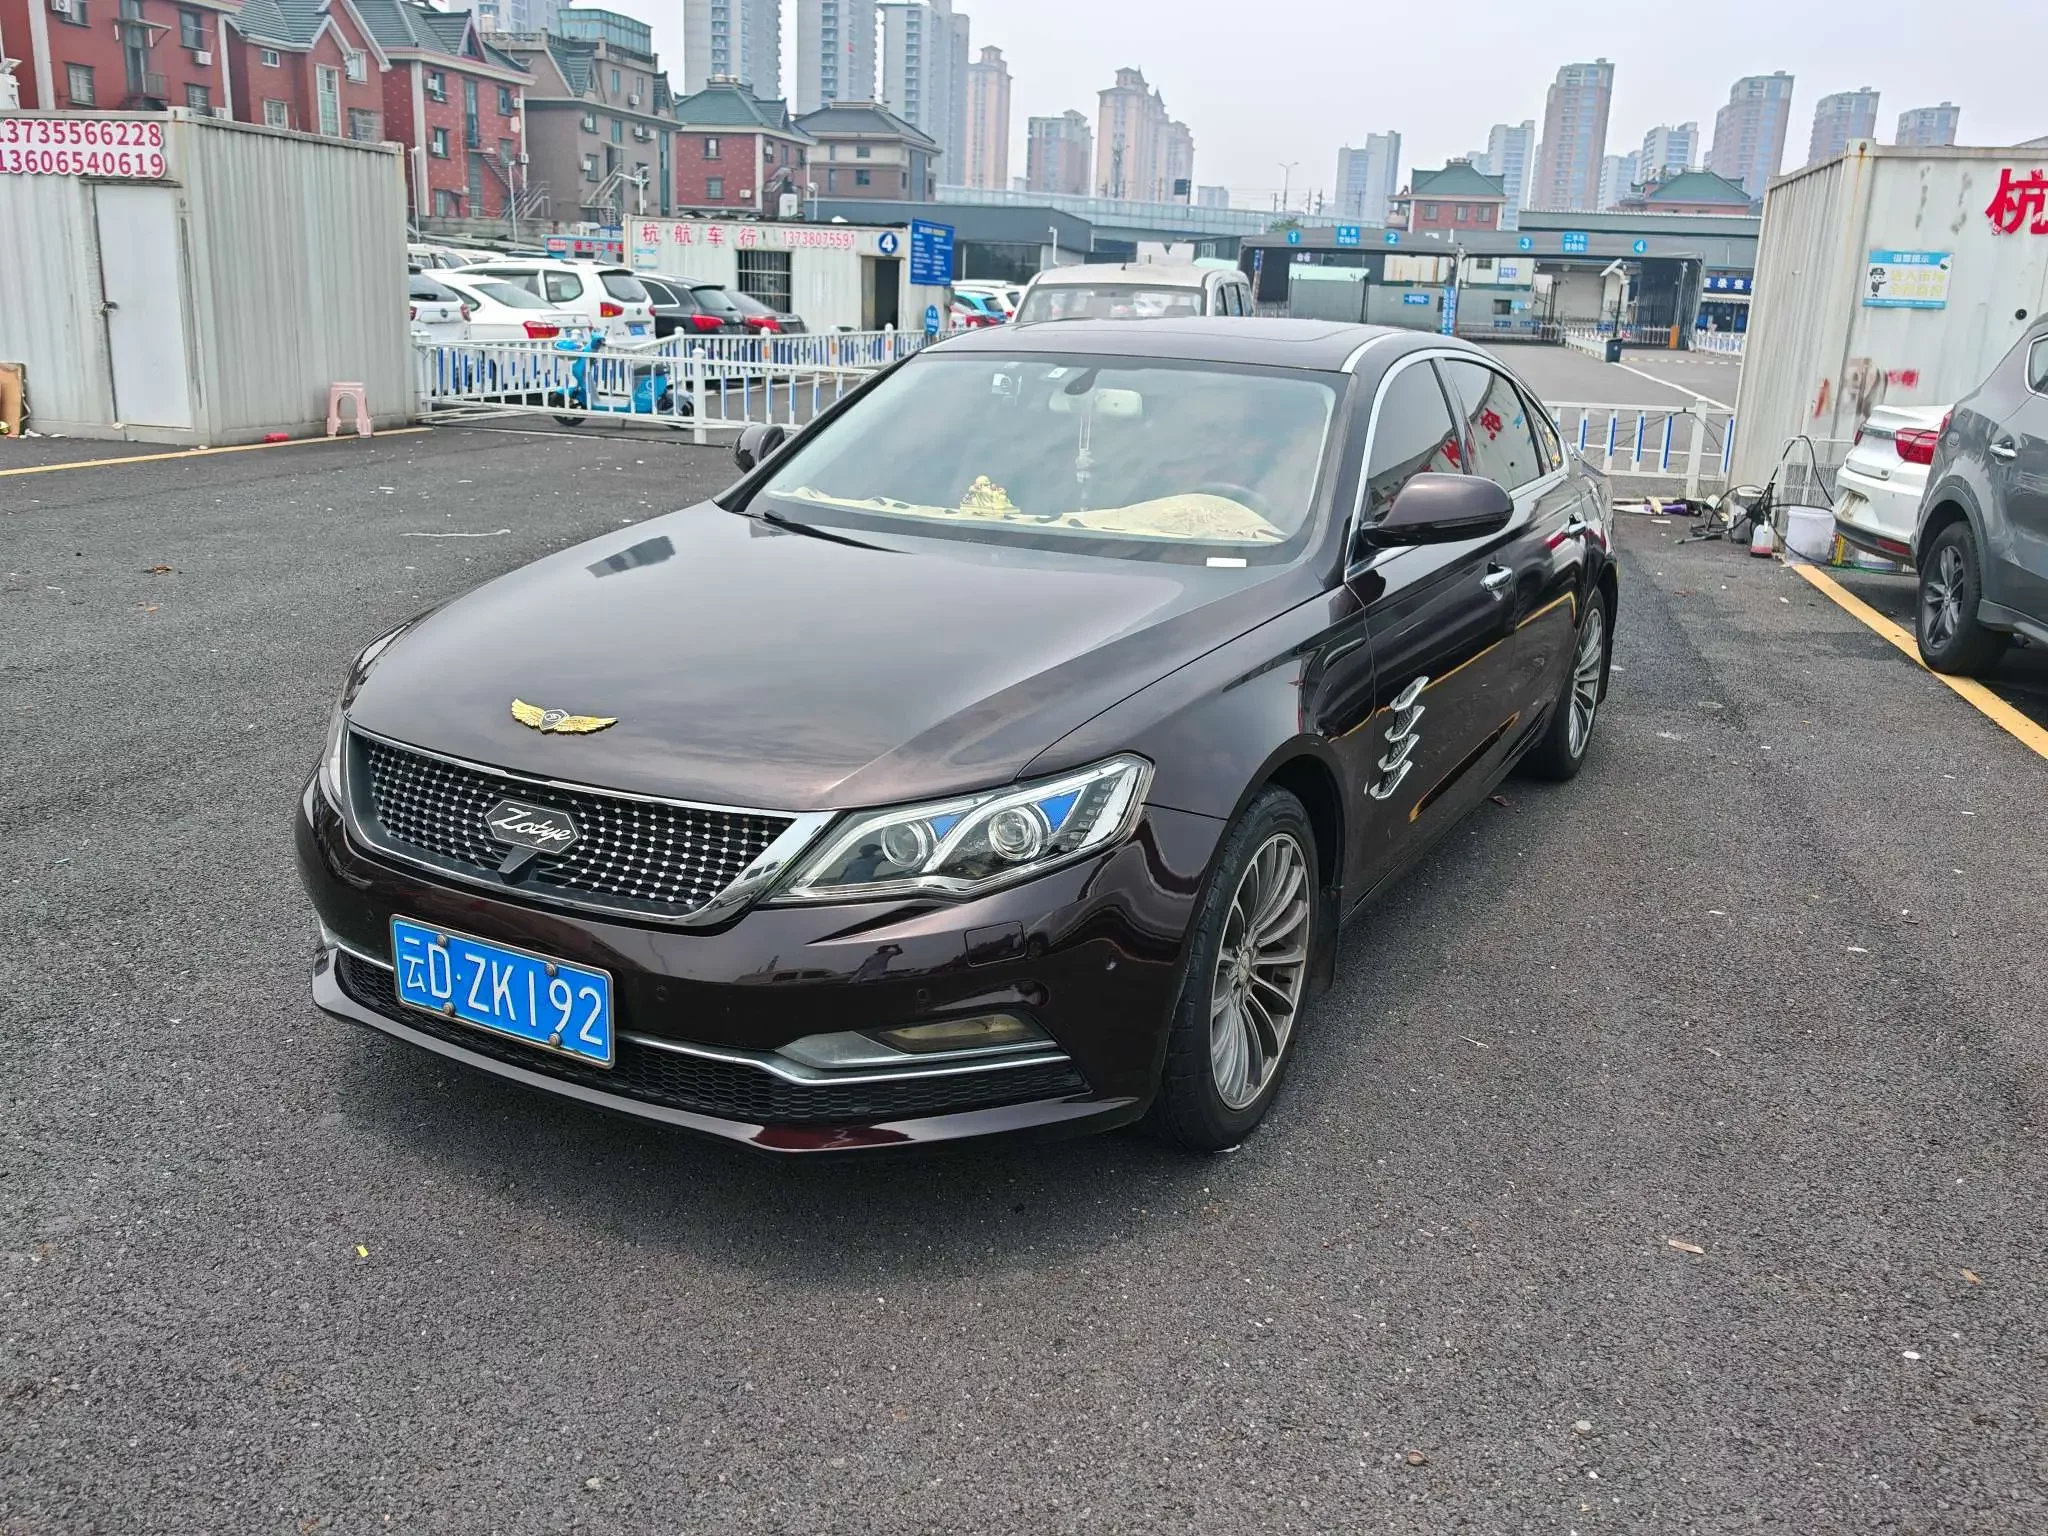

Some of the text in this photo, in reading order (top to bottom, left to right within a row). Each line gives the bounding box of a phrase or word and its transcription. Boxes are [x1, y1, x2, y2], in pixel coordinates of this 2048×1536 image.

[0, 121, 162, 147] 3735566228
[642, 222, 855, 248] 杭航车行 13738075591
[881, 234, 894, 251] 4
[490, 807, 572, 844] Zotye
